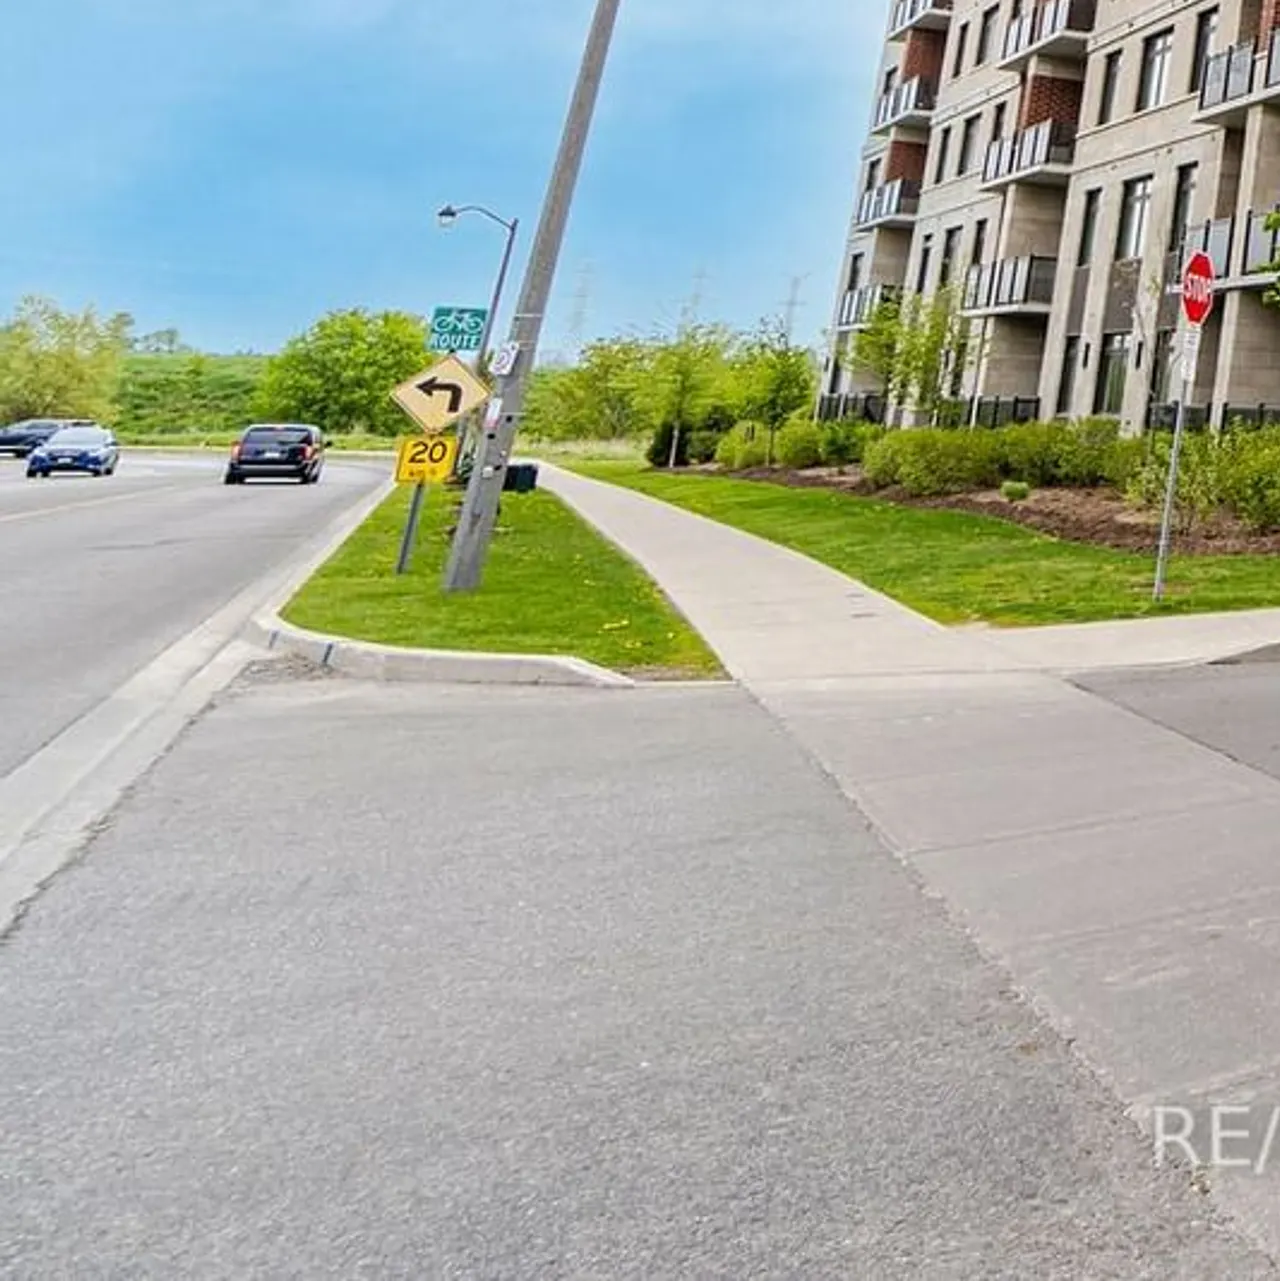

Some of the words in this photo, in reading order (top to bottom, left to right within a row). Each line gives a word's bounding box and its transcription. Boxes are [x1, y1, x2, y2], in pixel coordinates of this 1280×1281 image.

[1184, 272, 1211, 302] STOP
[431, 332, 480, 350] ROUTE
[408, 440, 447, 463] 20
